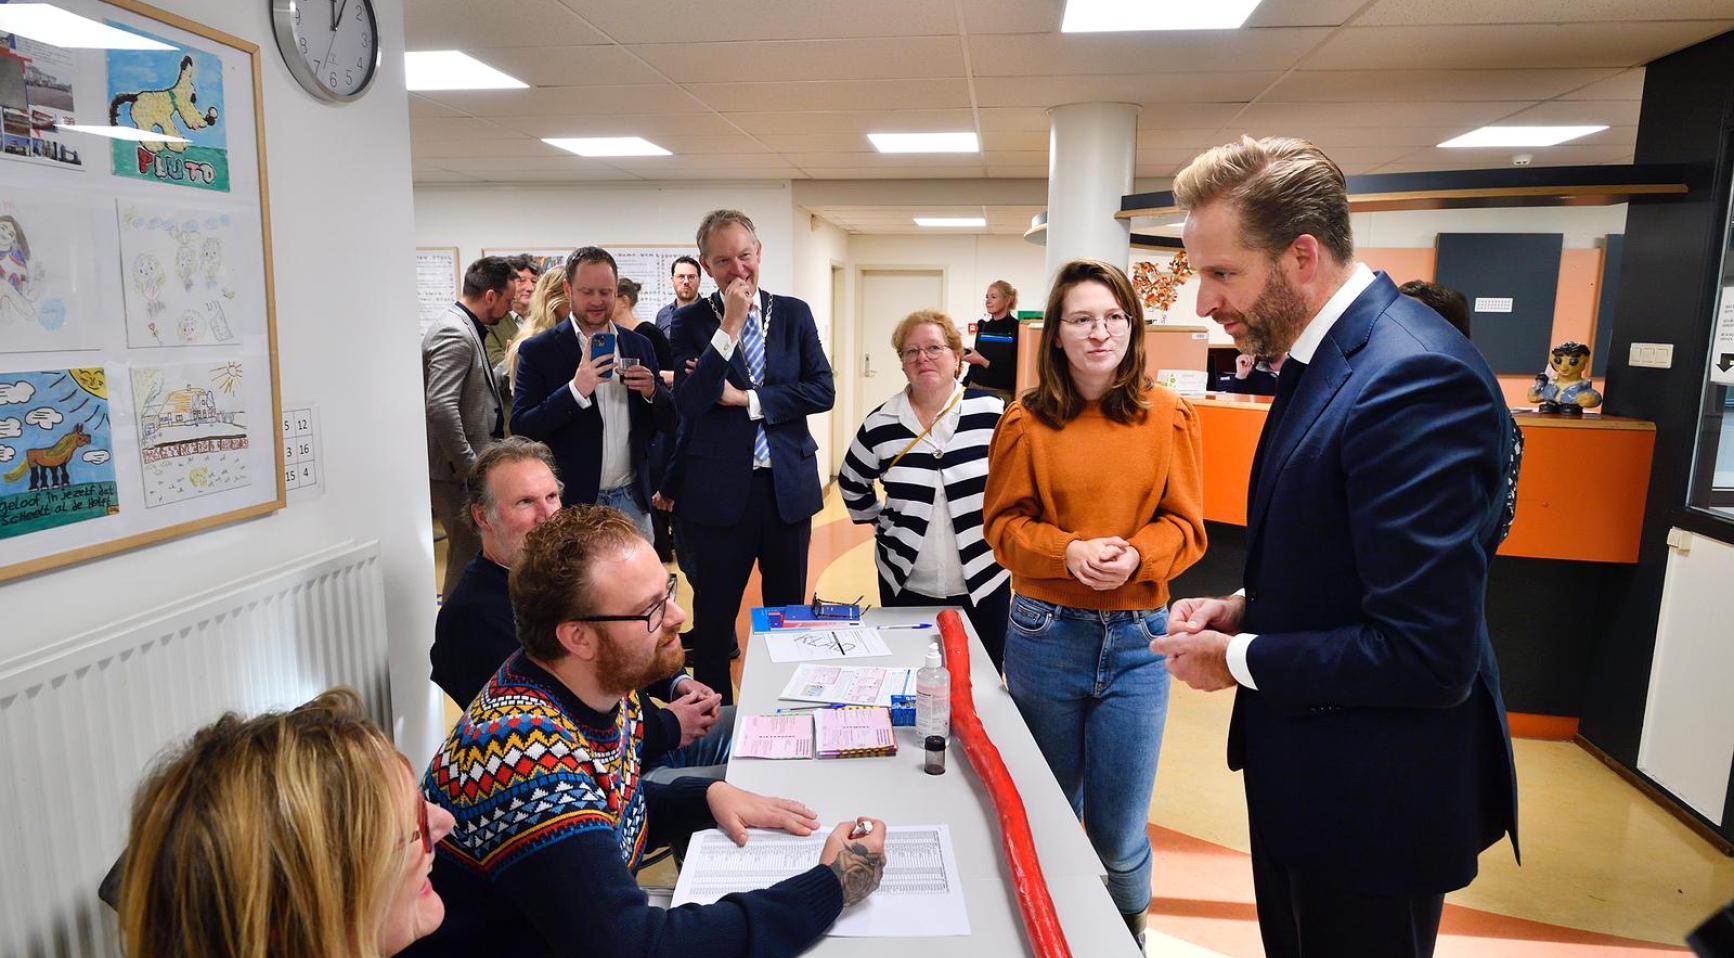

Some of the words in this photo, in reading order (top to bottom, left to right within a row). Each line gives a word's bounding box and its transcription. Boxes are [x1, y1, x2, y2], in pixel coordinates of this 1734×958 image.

[355, 5, 363, 21] 2
[361, 32, 368, 48] 3
[313, 59, 321, 76] 7
[357, 57, 363, 69] 4
[329, 71, 337, 88] 6
[345, 69, 352, 86] 5
[137, 147, 216, 184] PLUTO
[297, 419, 308, 431] 12
[299, 443, 310, 455] 16
[286, 470, 296, 482] 15
[303, 467, 309, 477] 4
